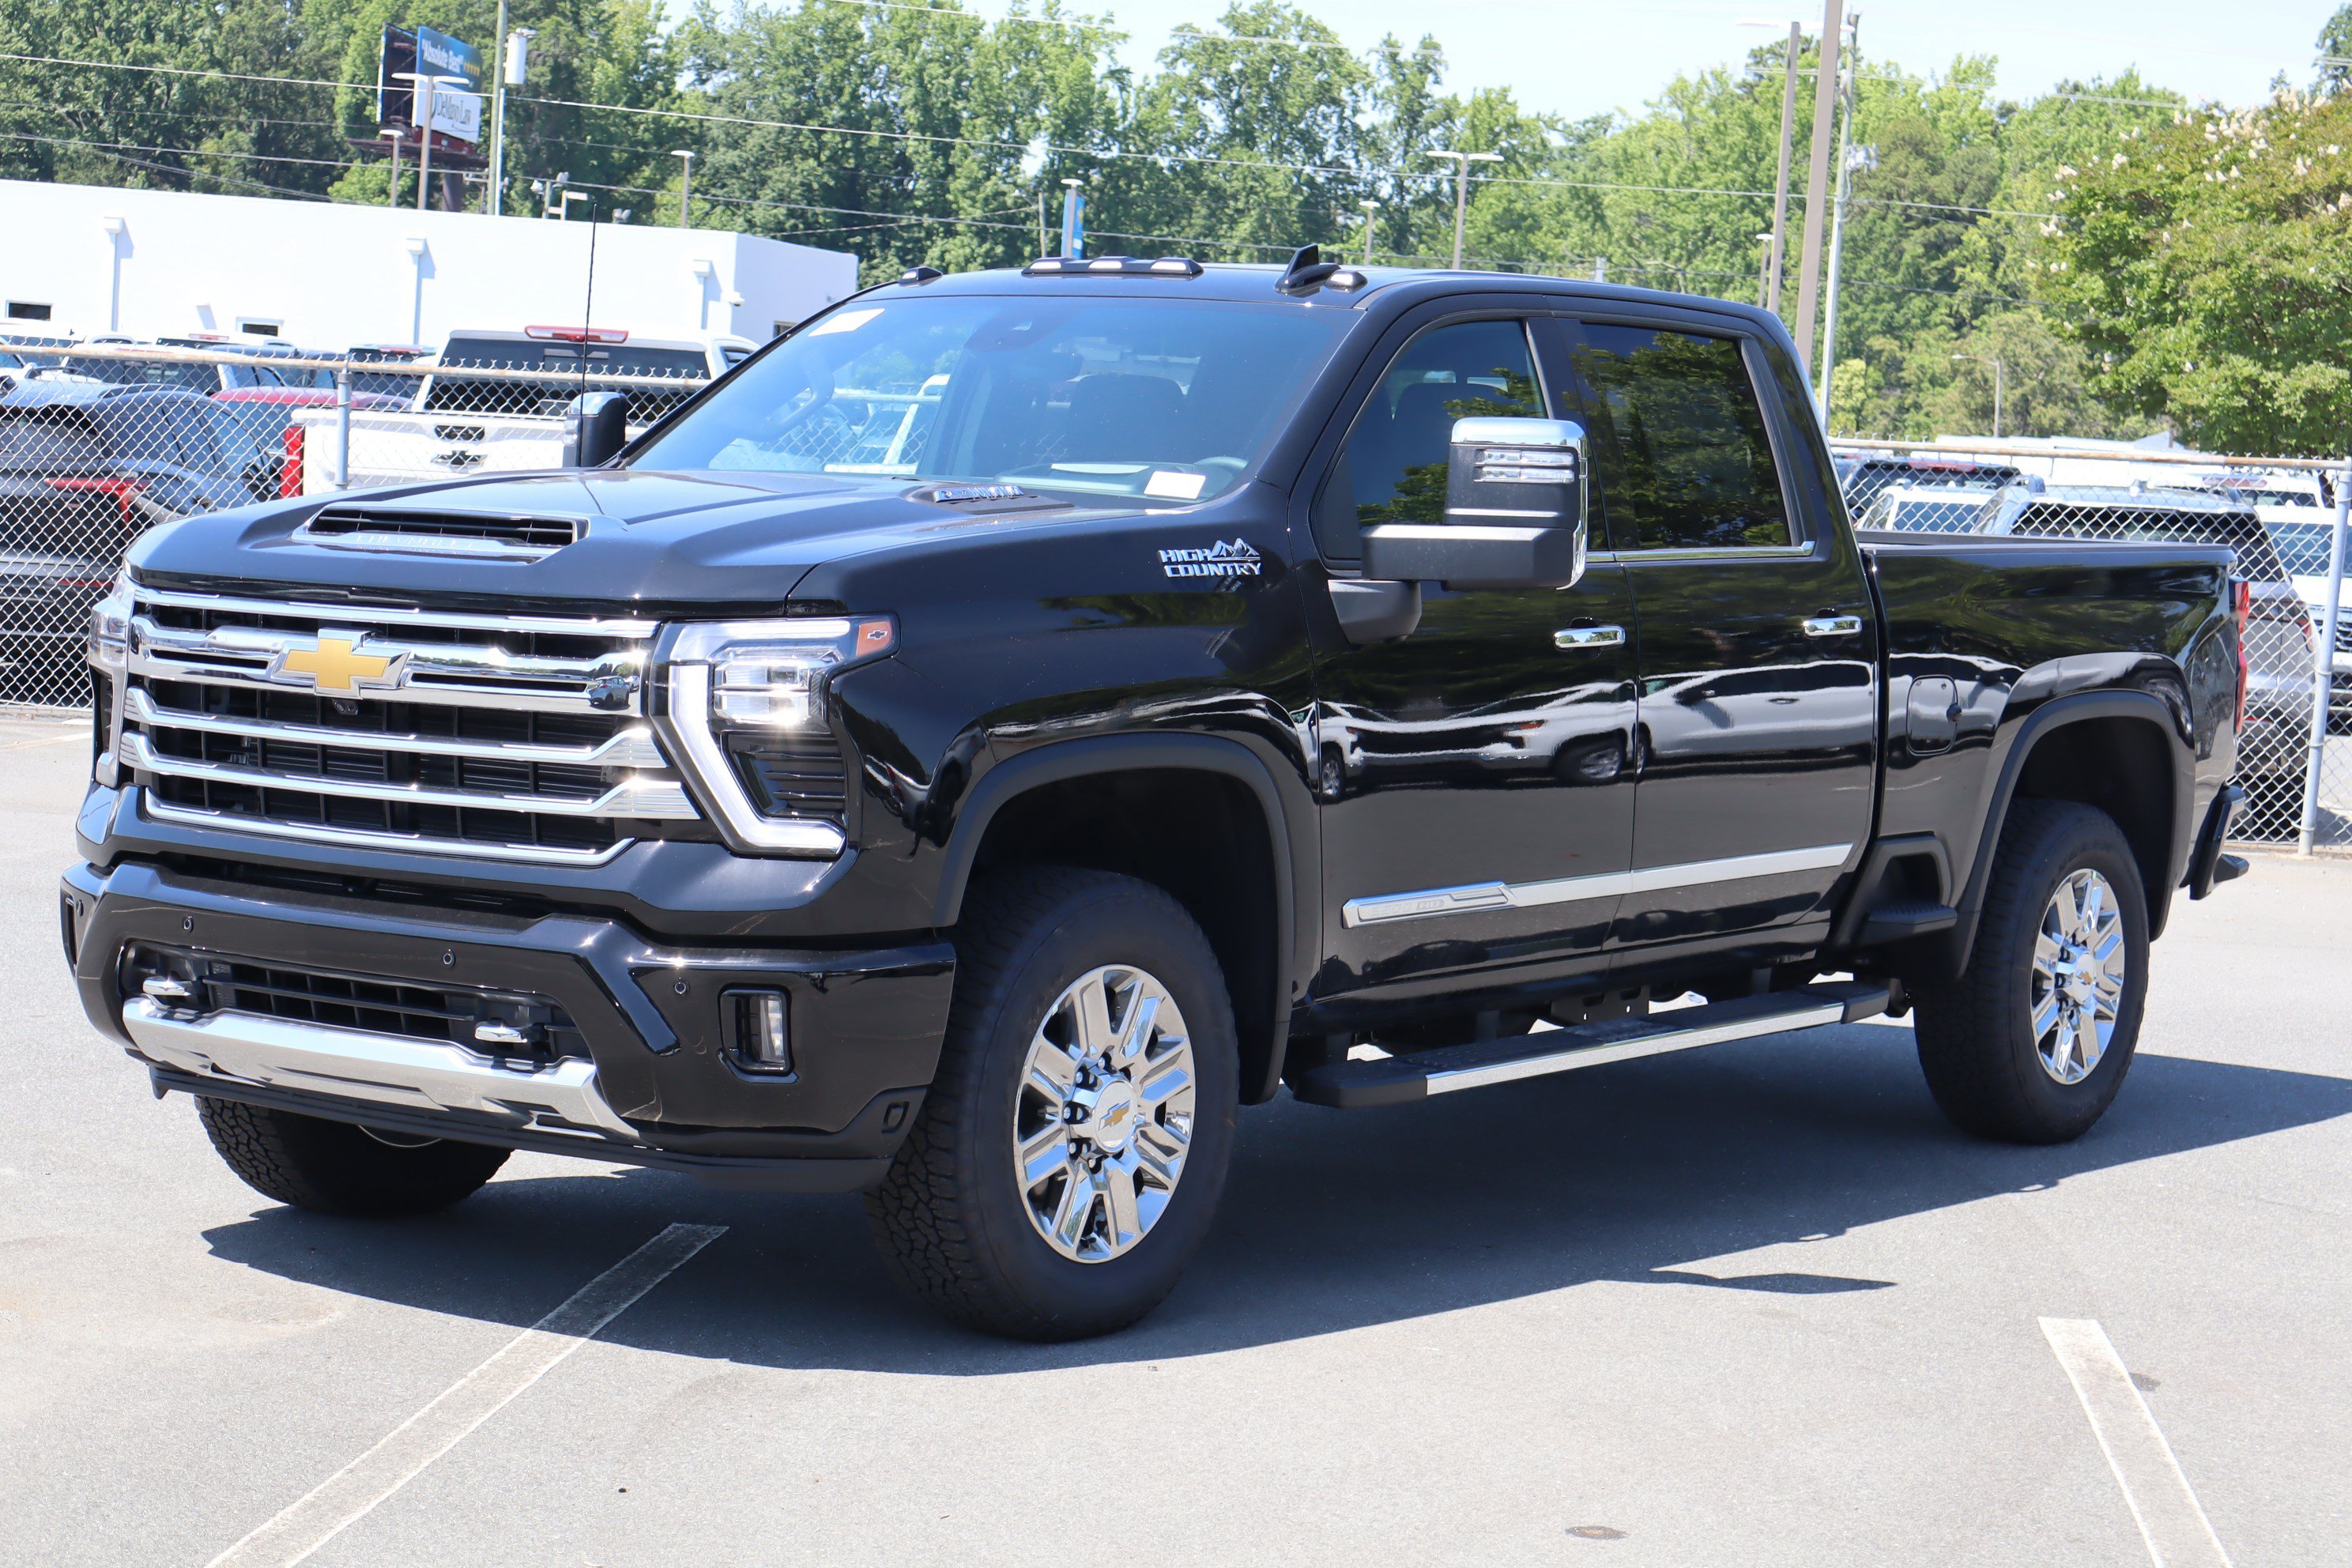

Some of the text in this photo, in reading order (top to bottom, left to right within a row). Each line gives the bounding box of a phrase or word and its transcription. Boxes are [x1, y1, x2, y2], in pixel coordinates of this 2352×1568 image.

[460, 100, 472, 125] Law
[1158, 548, 1212, 563] HIGH
[1163, 563, 1262, 578] COUNTRY
